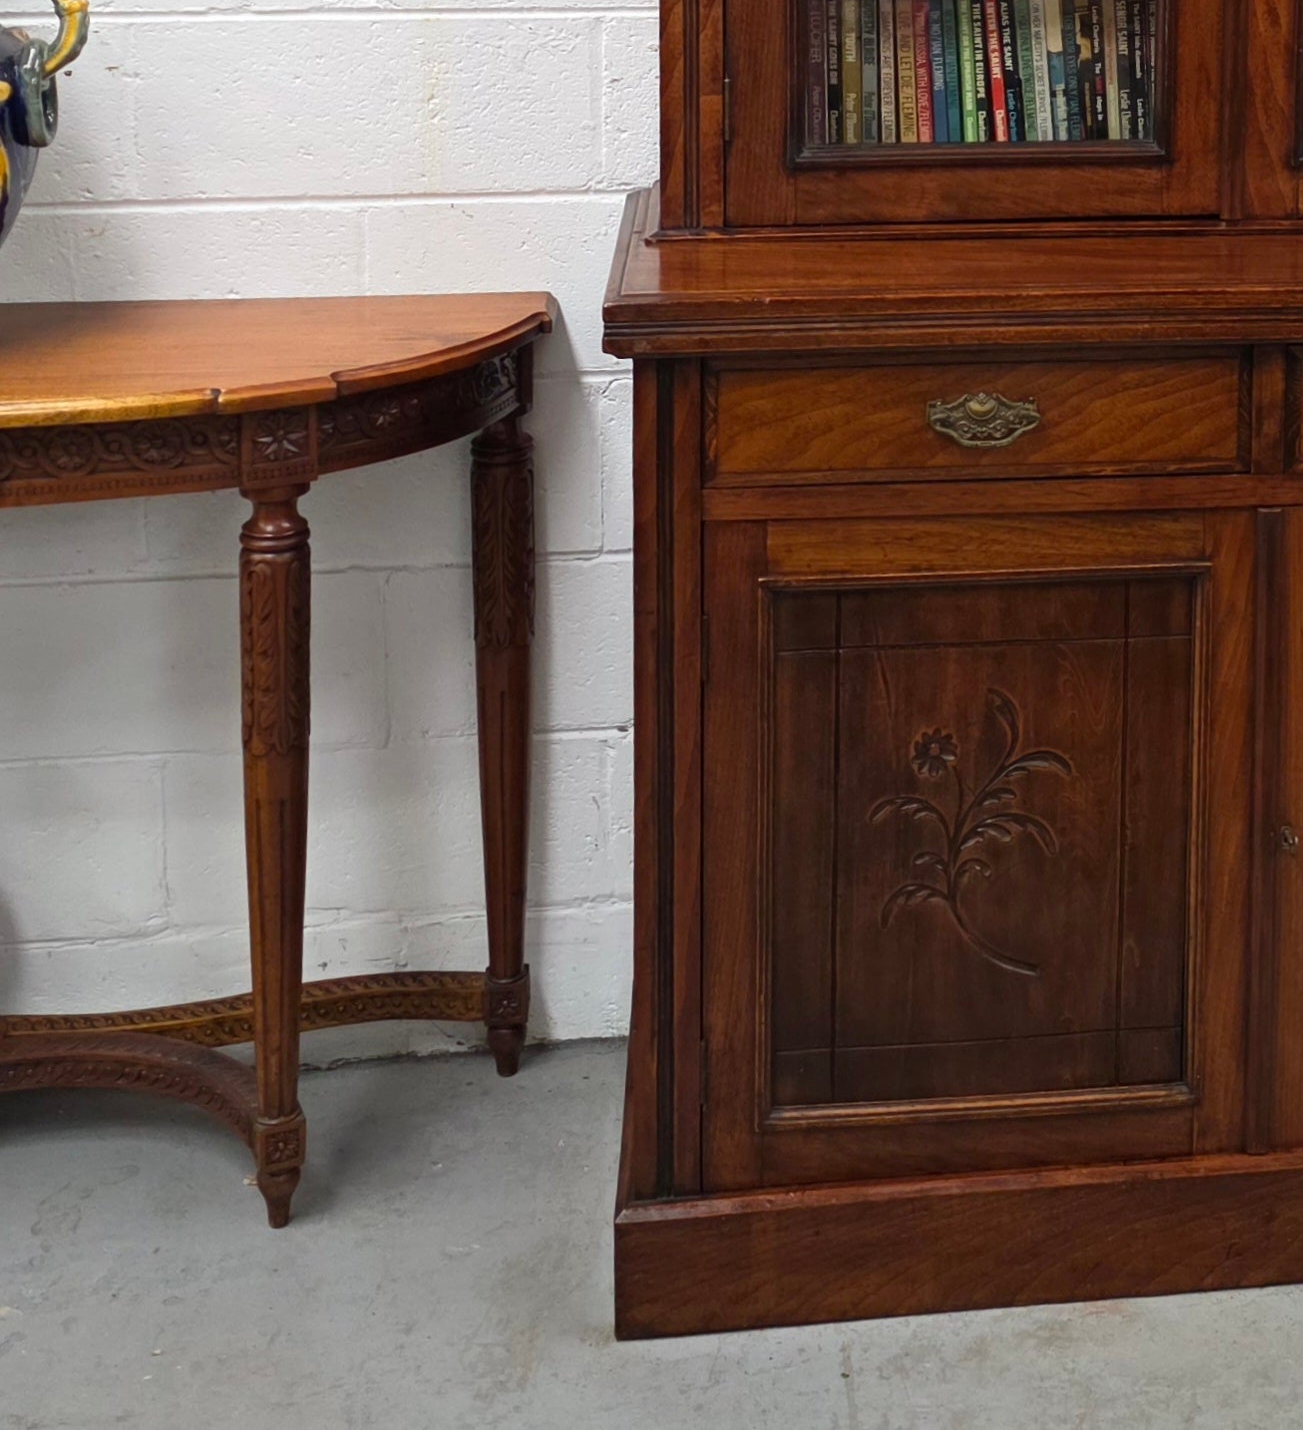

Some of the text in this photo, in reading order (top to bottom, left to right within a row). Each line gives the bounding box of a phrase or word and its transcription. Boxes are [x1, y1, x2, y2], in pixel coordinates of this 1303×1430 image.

[898, 11, 911, 71] LIVE AND LET
[986, 1, 1002, 79] ENTER THE SAINT
[1000, 1, 1013, 71] ALIAS THE SAINT
[1021, 31, 1031, 53] ONLY
[1065, 32, 1075, 53] YOUR
[1092, 25, 1100, 53] Charteris
[1117, 31, 1129, 56] SAINT
[972, 3, 986, 99] THE SAINT IN EUROPE
[1031, 2, 1048, 114] ON HER MAJESTY'S SECRET SERVICE
[933, 57, 944, 90] FLEMING
[1094, 62, 1102, 74] The
[846, 93, 857, 111] Peter
[1007, 89, 1016, 110] Leslie
[1095, 96, 1104, 113] steps
[1120, 89, 1130, 110] Leslie
